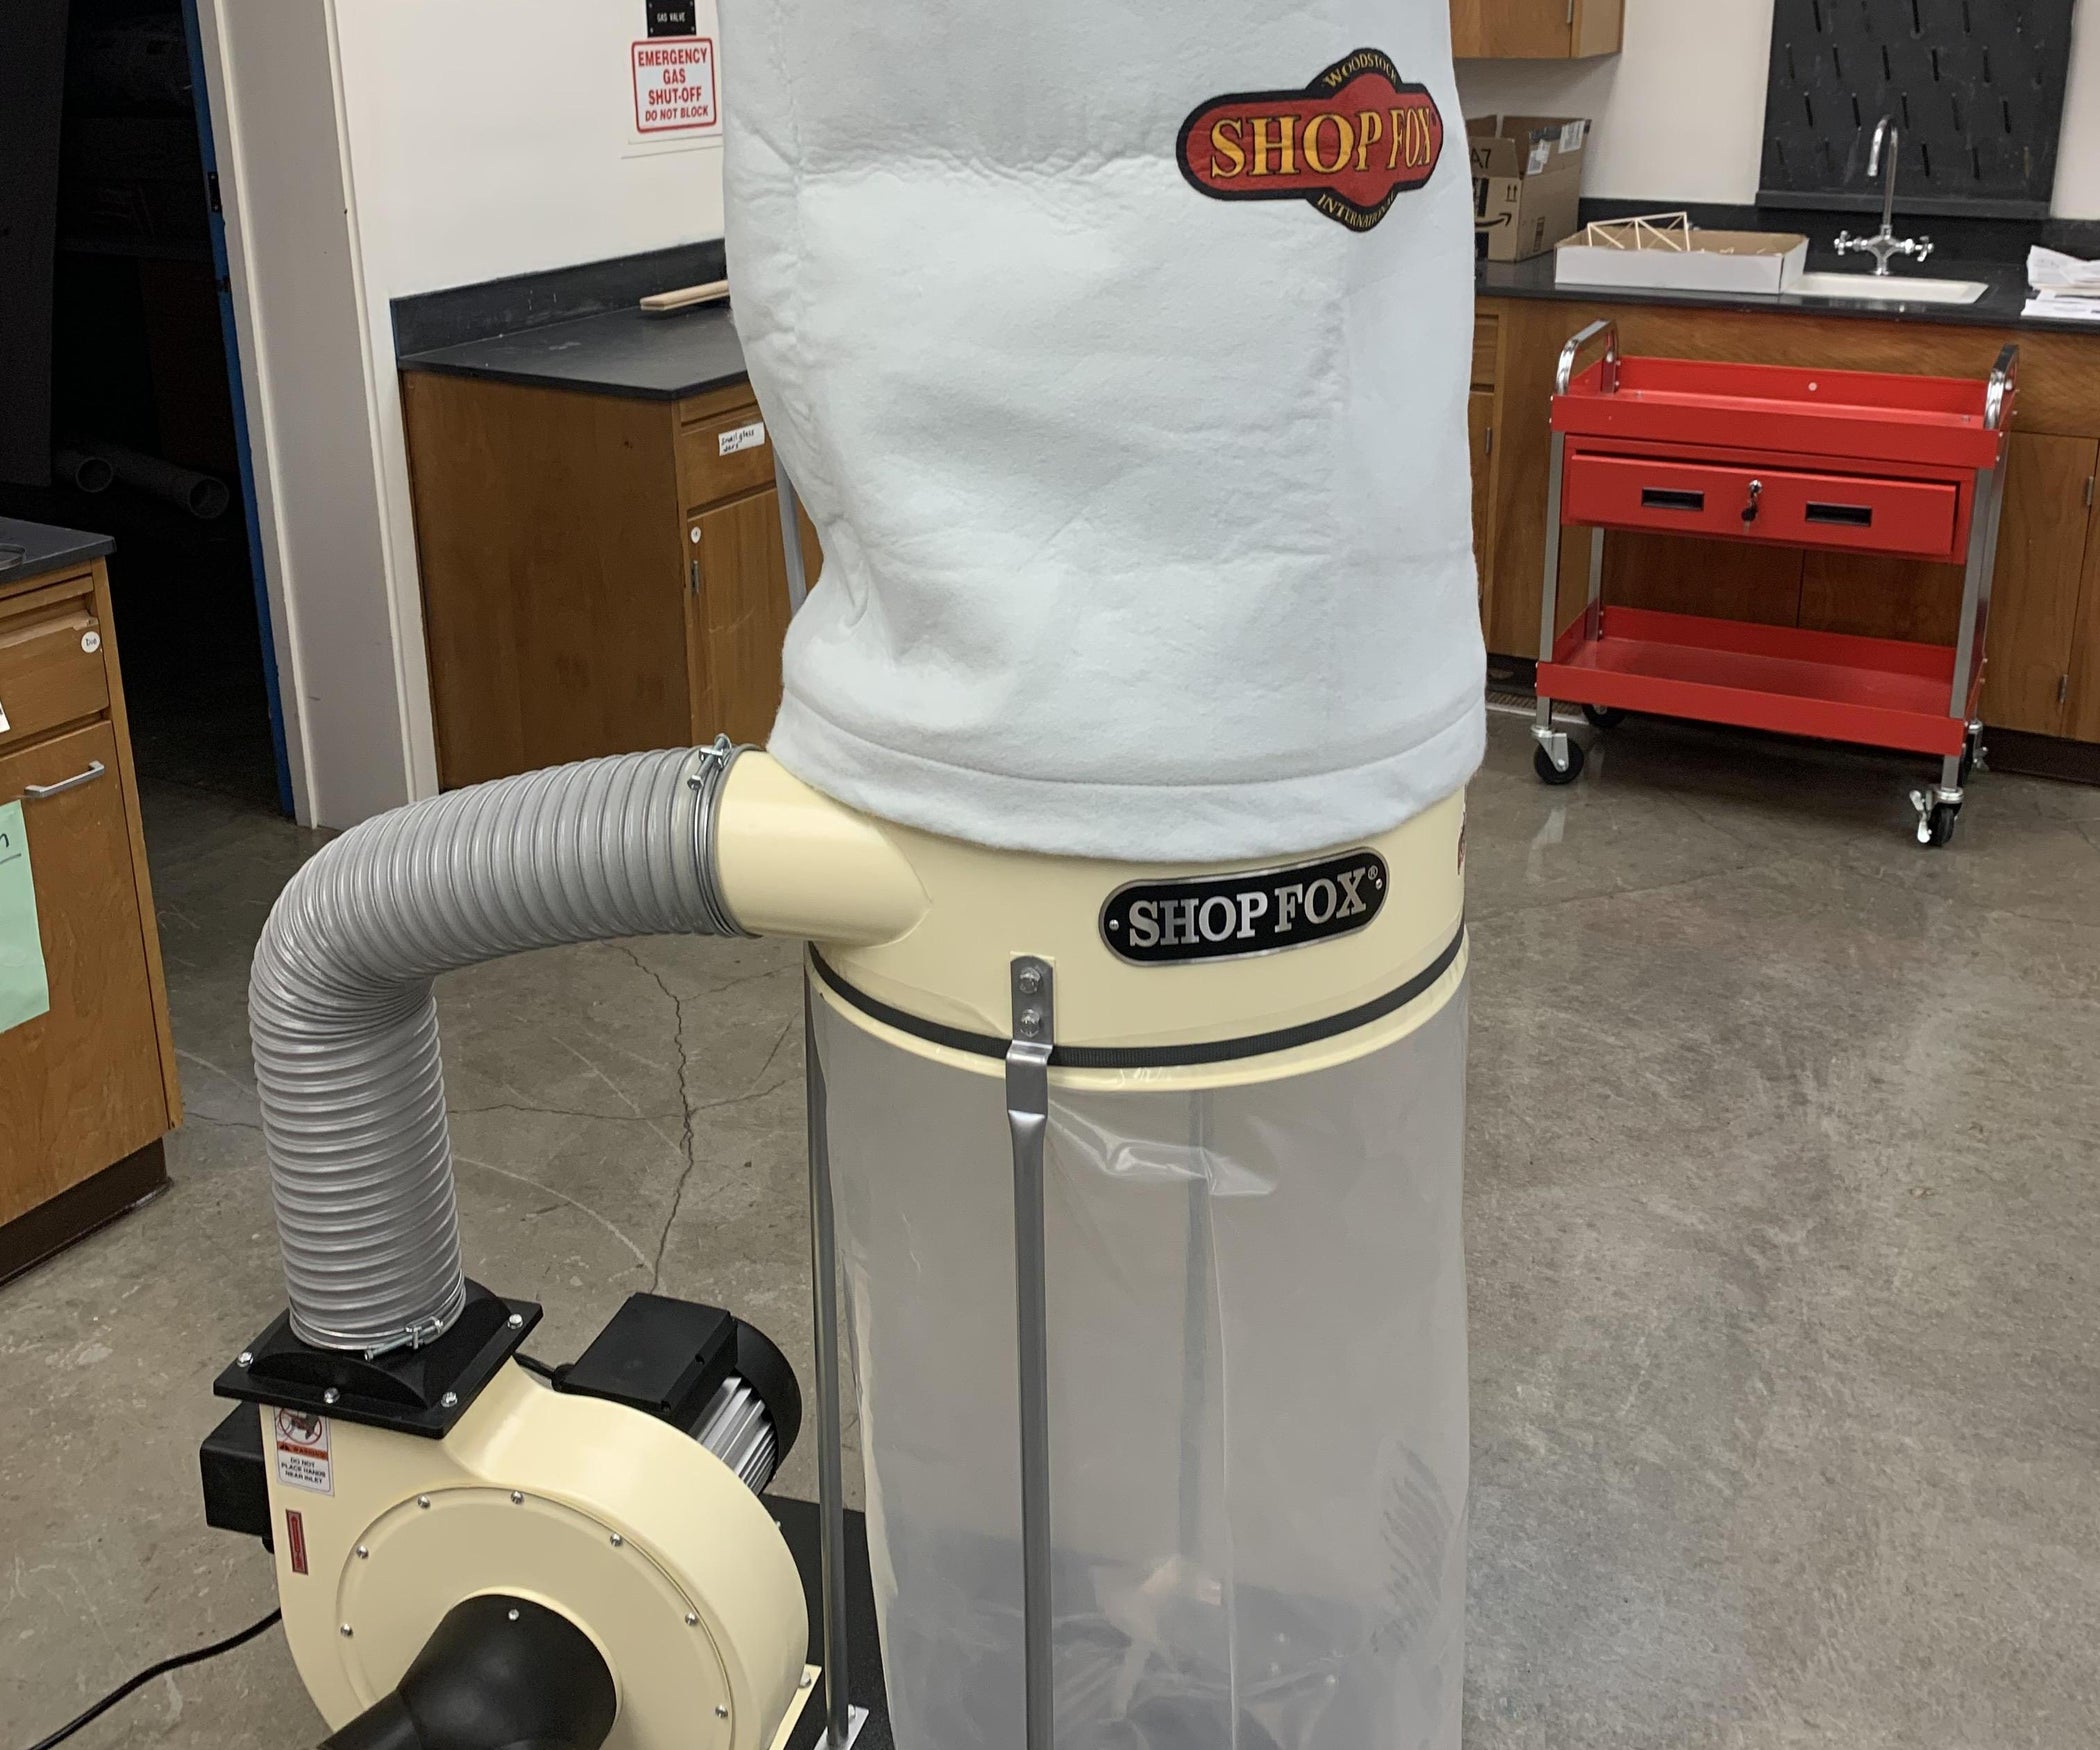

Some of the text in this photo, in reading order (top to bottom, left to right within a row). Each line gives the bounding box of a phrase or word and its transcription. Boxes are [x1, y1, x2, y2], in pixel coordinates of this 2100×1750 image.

[670, 11, 686, 23] VALVE
[638, 47, 708, 67] EMERGENCY
[663, 68, 686, 85] GAS
[1322, 52, 1397, 89] WOODSTOCK
[648, 86, 702, 106] SHUT-OFF
[645, 105, 709, 122] DO NOT BLOCK
[1210, 107, 1432, 179] SHOP FOX
[1128, 891, 1269, 948] SHOP
